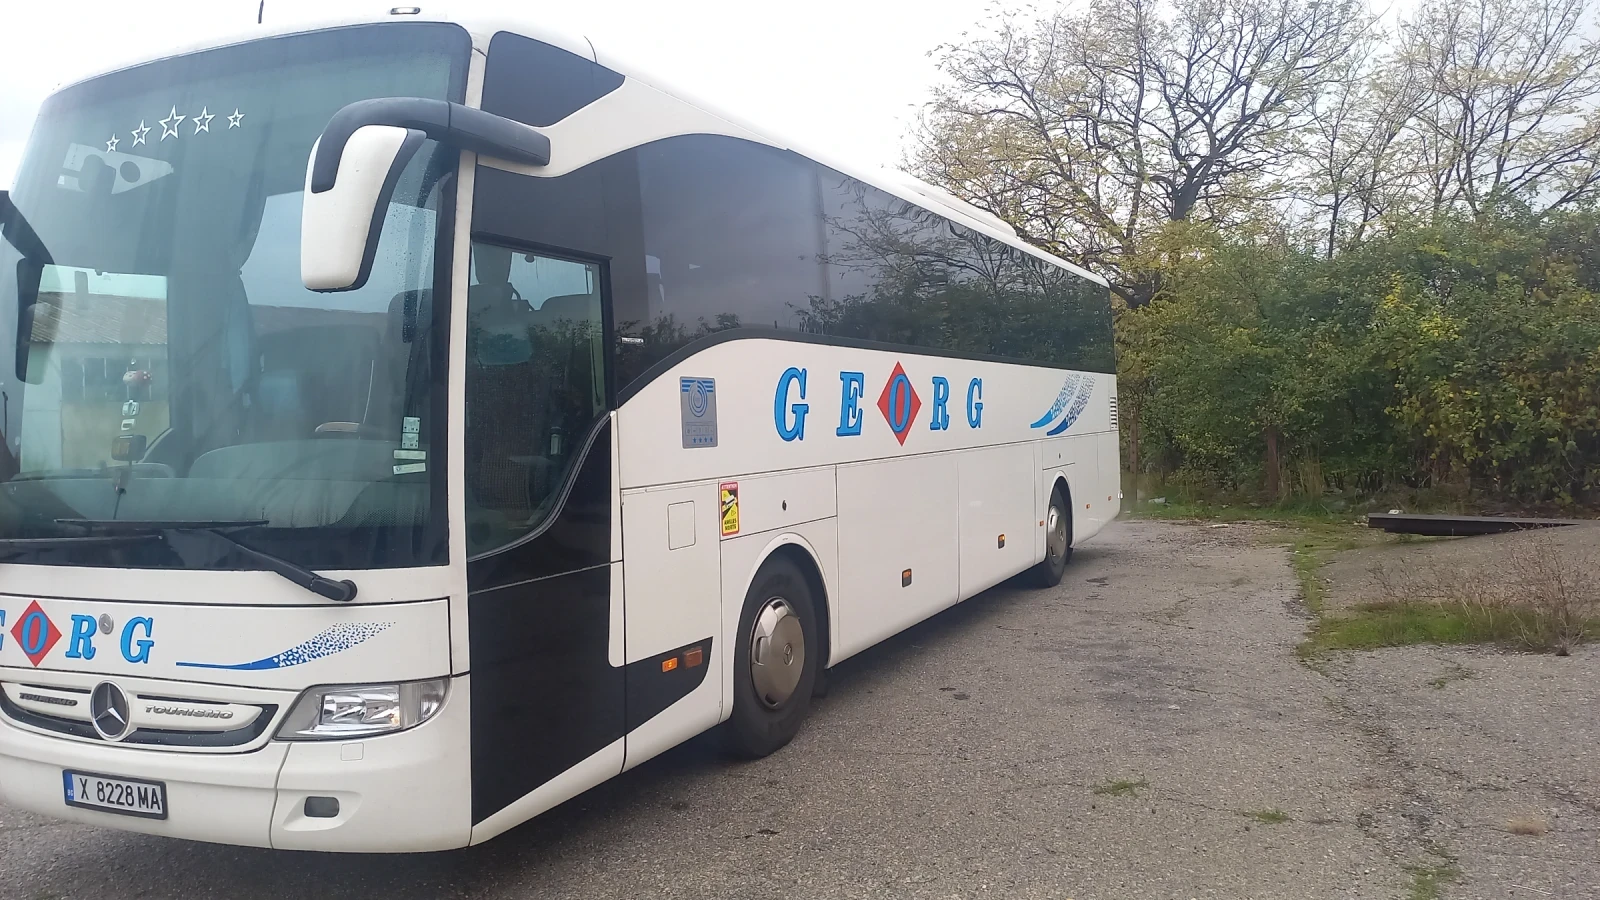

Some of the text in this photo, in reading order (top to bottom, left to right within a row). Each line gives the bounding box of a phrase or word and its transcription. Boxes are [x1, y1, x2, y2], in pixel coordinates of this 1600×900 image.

[774, 366, 983, 442] GEORG
[0, 609, 155, 664] ORG
[19, 692, 78, 707] TOURISMO
[145, 705, 234, 719] TOURISMO
[79, 777, 161, 811] X 8228 MA
